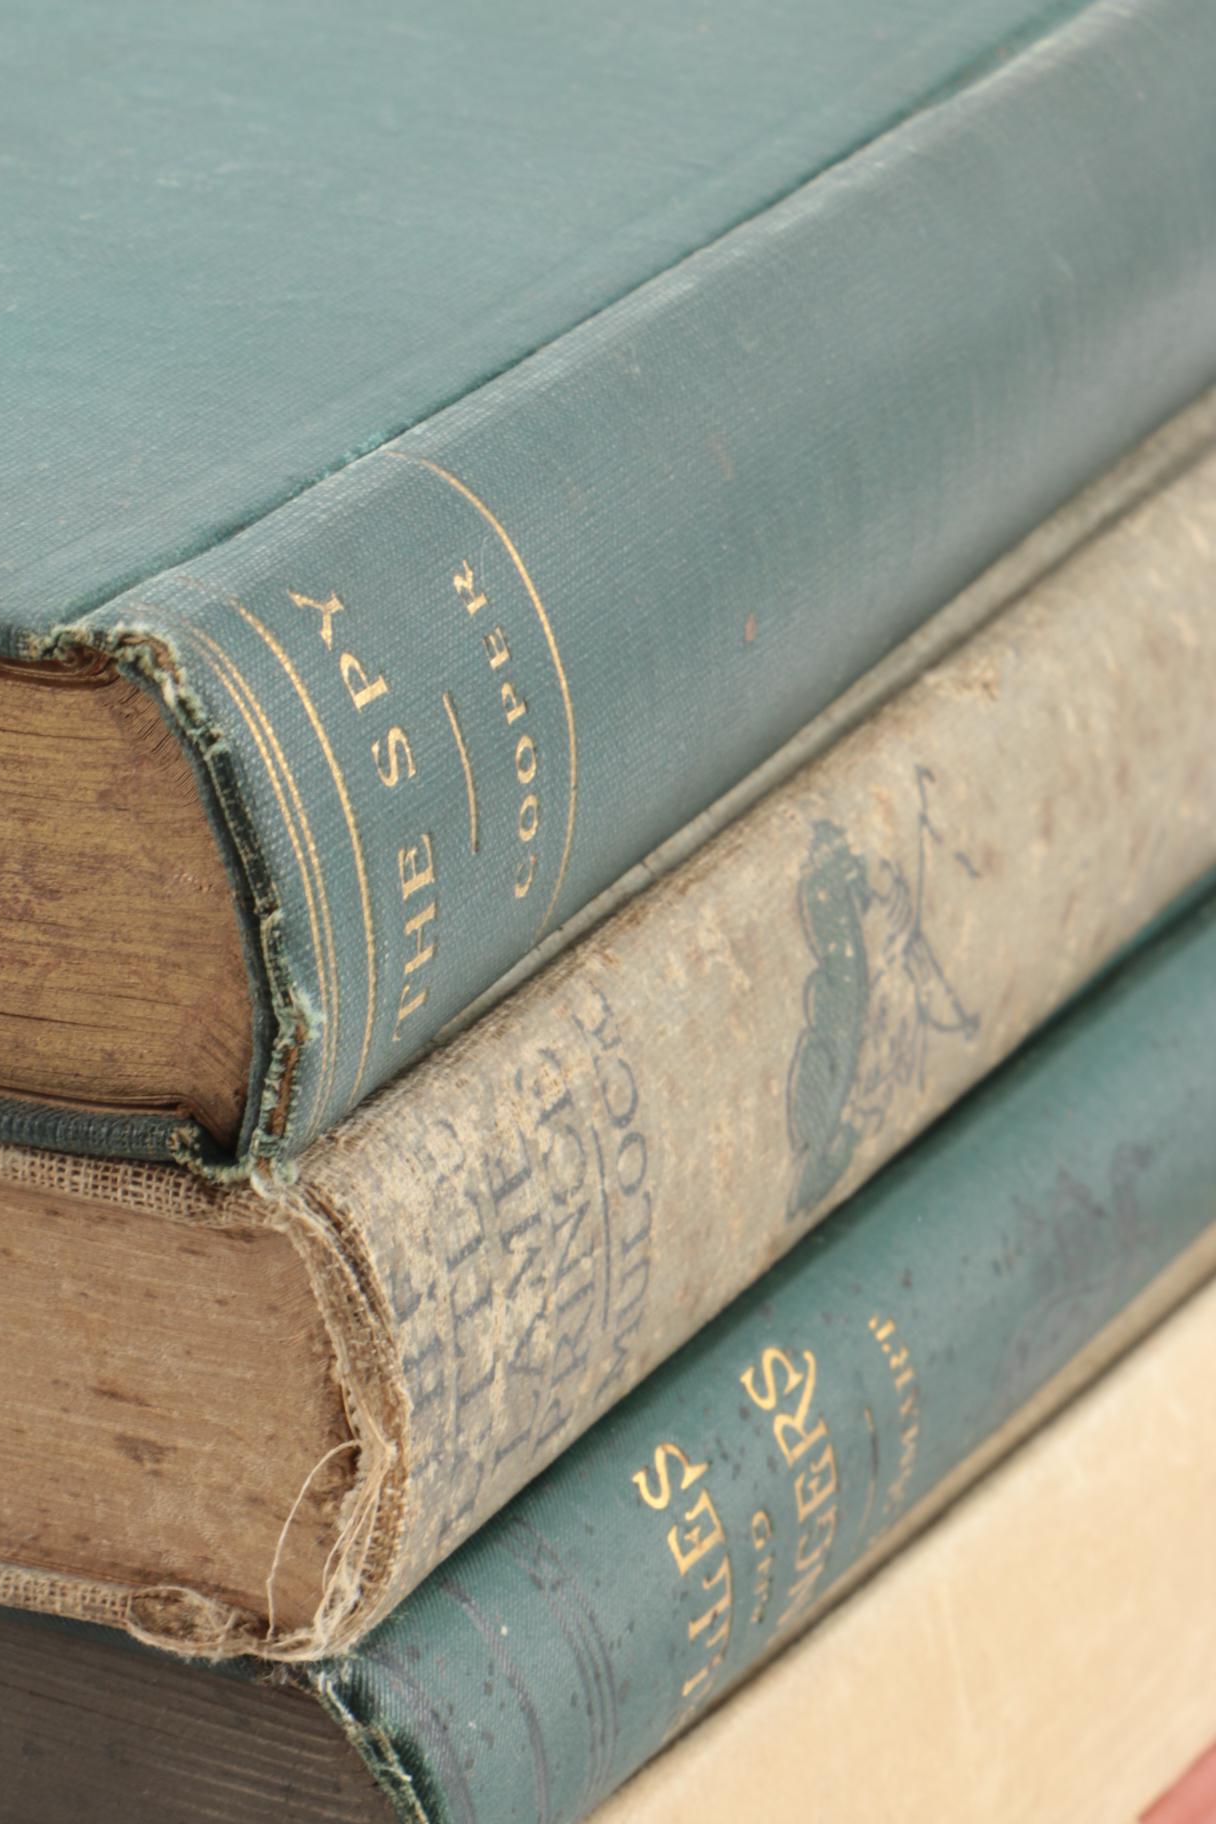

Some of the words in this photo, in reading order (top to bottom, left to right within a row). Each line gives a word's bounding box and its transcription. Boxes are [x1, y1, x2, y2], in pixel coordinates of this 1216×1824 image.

[286, 586, 417, 788] SPY
[453, 558, 540, 901] COOPER
[392, 830, 438, 1043] THE
